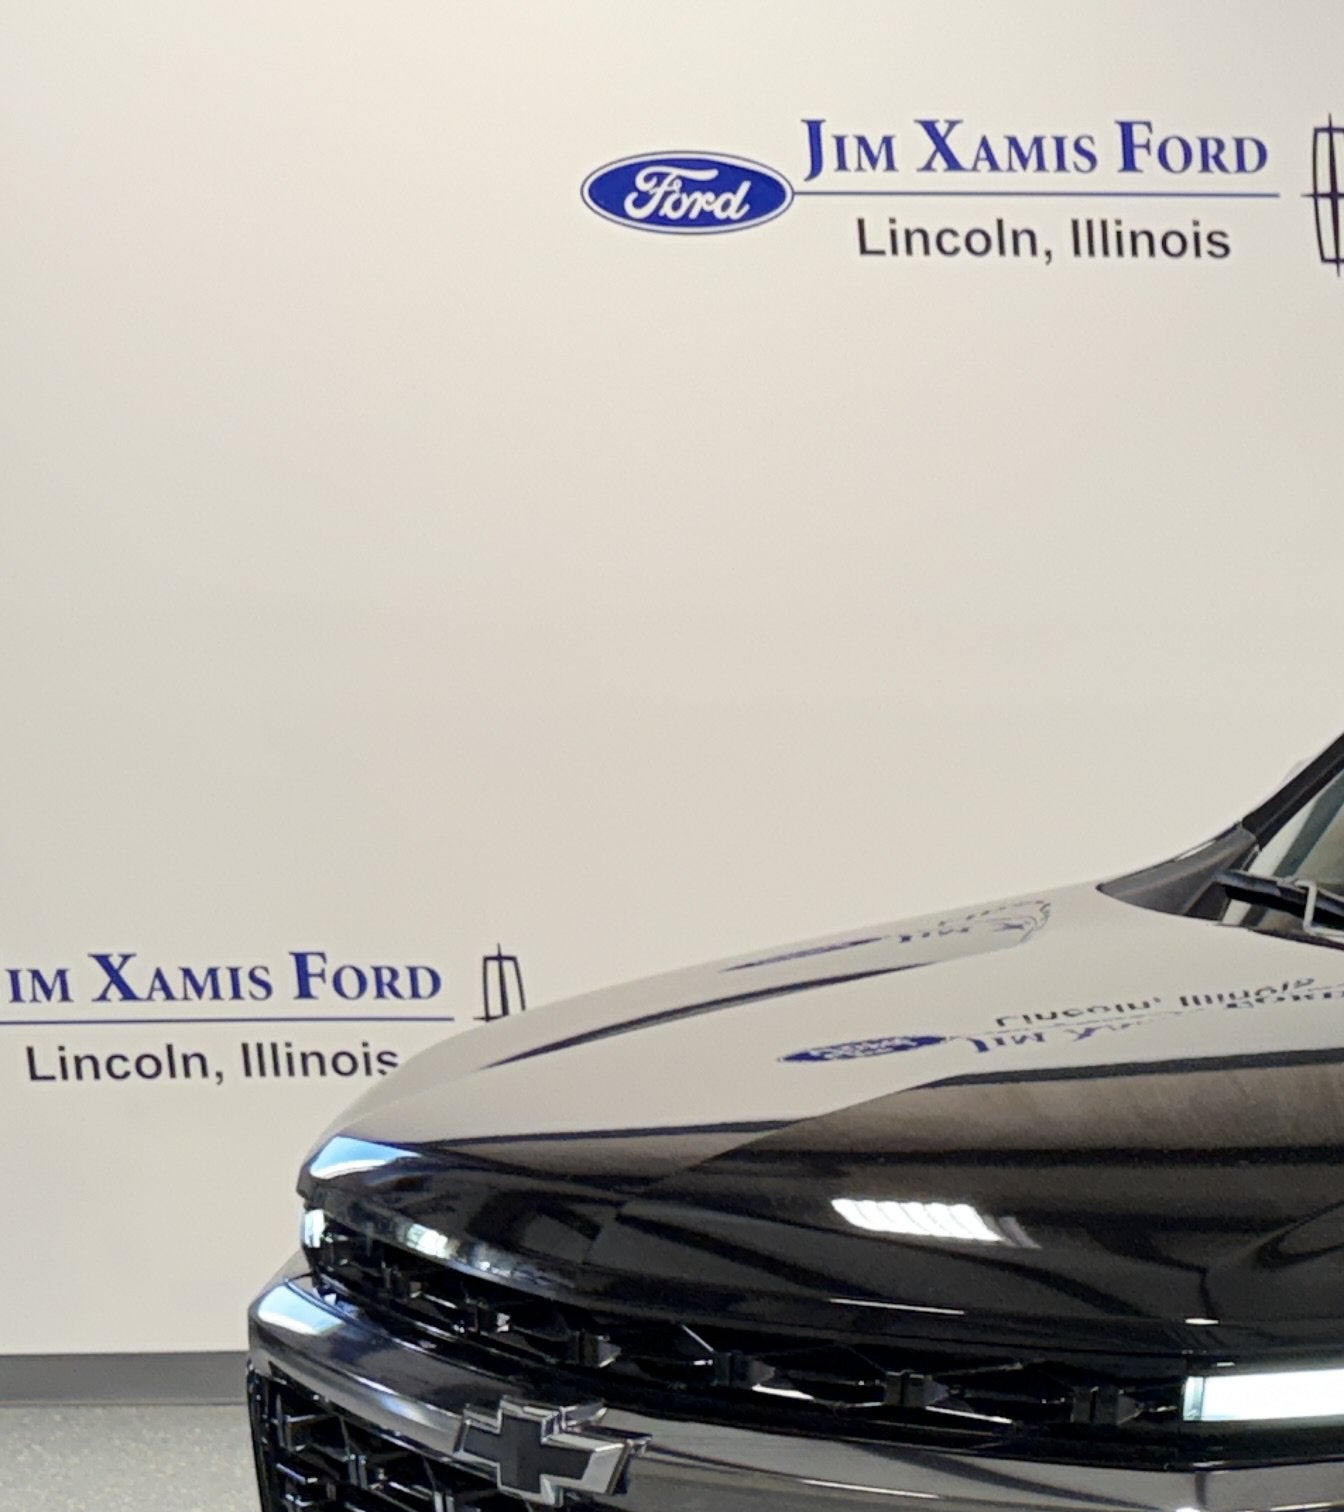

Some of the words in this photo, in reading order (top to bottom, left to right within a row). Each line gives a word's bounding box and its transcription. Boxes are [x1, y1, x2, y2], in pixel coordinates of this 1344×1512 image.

[801, 119, 898, 182] JIM
[915, 119, 1099, 174] XAMIS
[1115, 119, 1269, 174] FORD
[623, 164, 751, 223] Ford
[857, 216, 1053, 265] Lincoln,
[1071, 218, 1232, 260] Illinois
[6, 967, 73, 1004] IM
[87, 952, 274, 1003] XAMIS
[287, 950, 443, 1001] FORD
[26, 1042, 225, 1086] Lincoln,
[241, 1041, 400, 1080] Illinois
